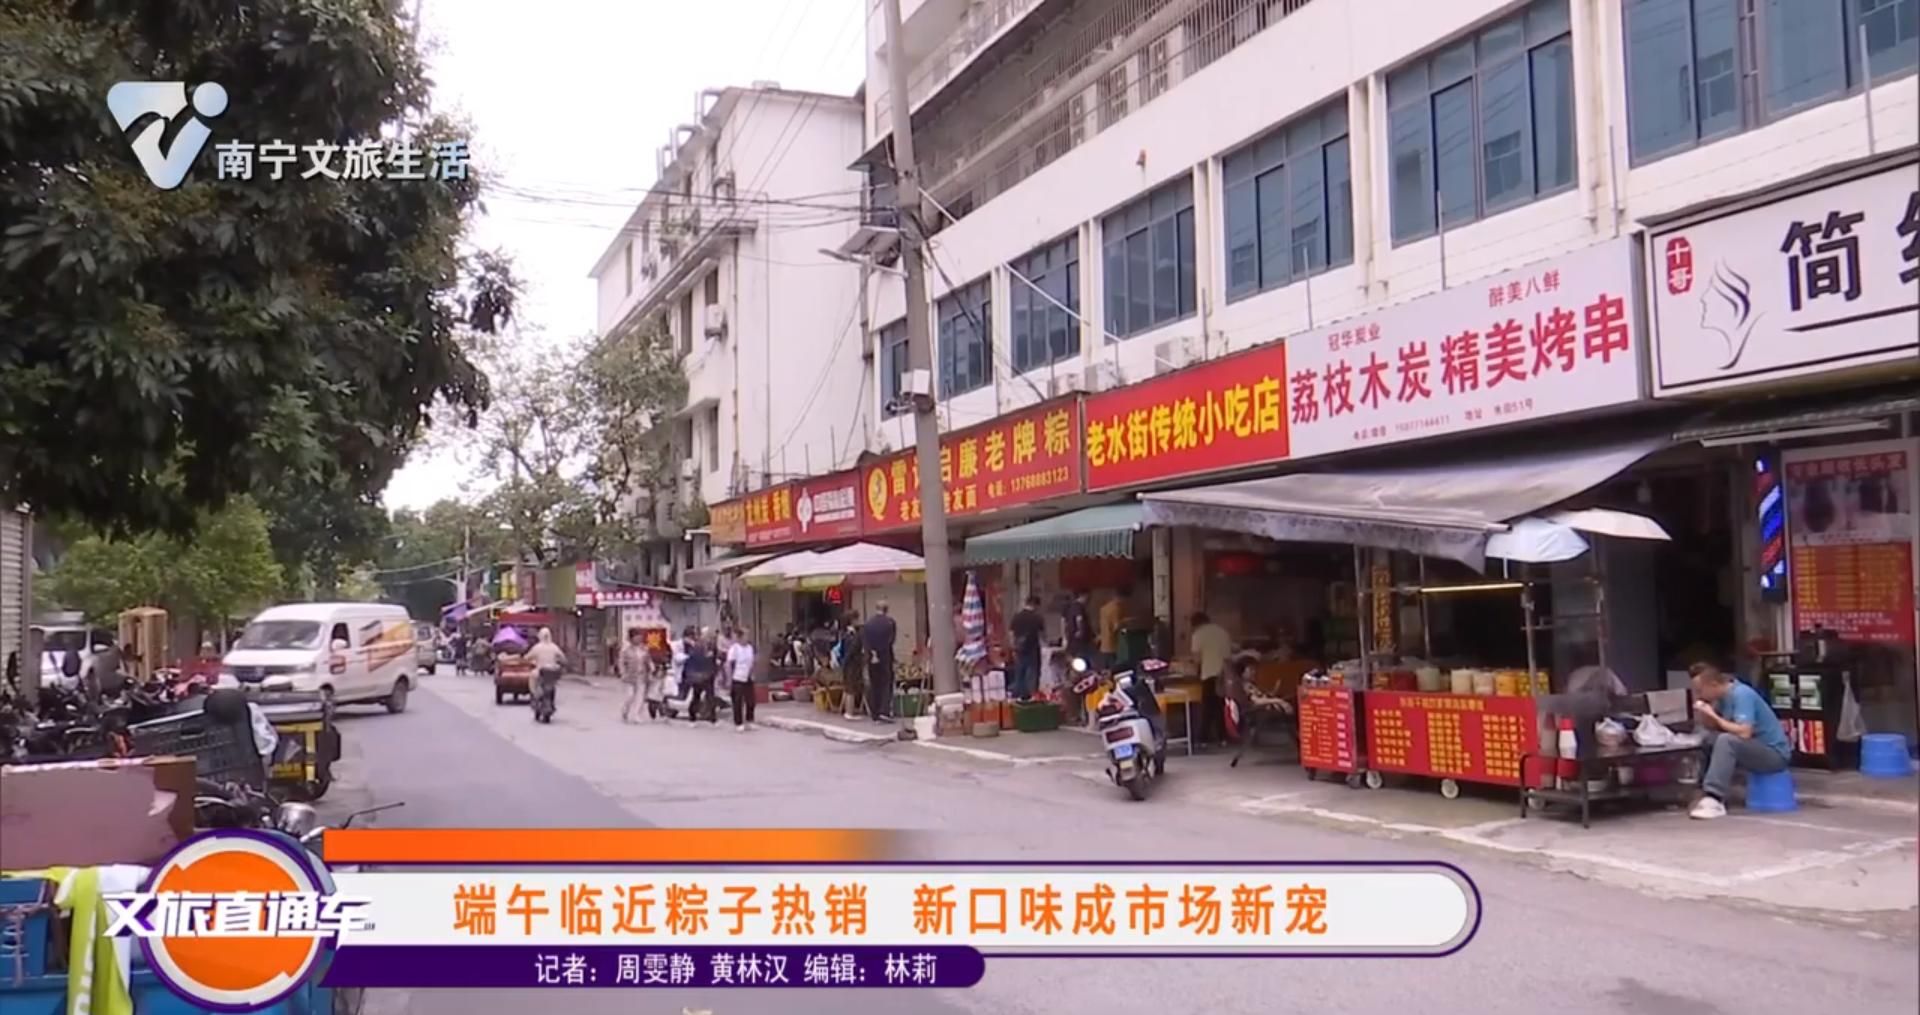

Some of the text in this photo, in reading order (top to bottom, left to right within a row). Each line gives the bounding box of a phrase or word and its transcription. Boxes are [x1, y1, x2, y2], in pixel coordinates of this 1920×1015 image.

[1086, 375, 1281, 467] 老水街传统小吃店
